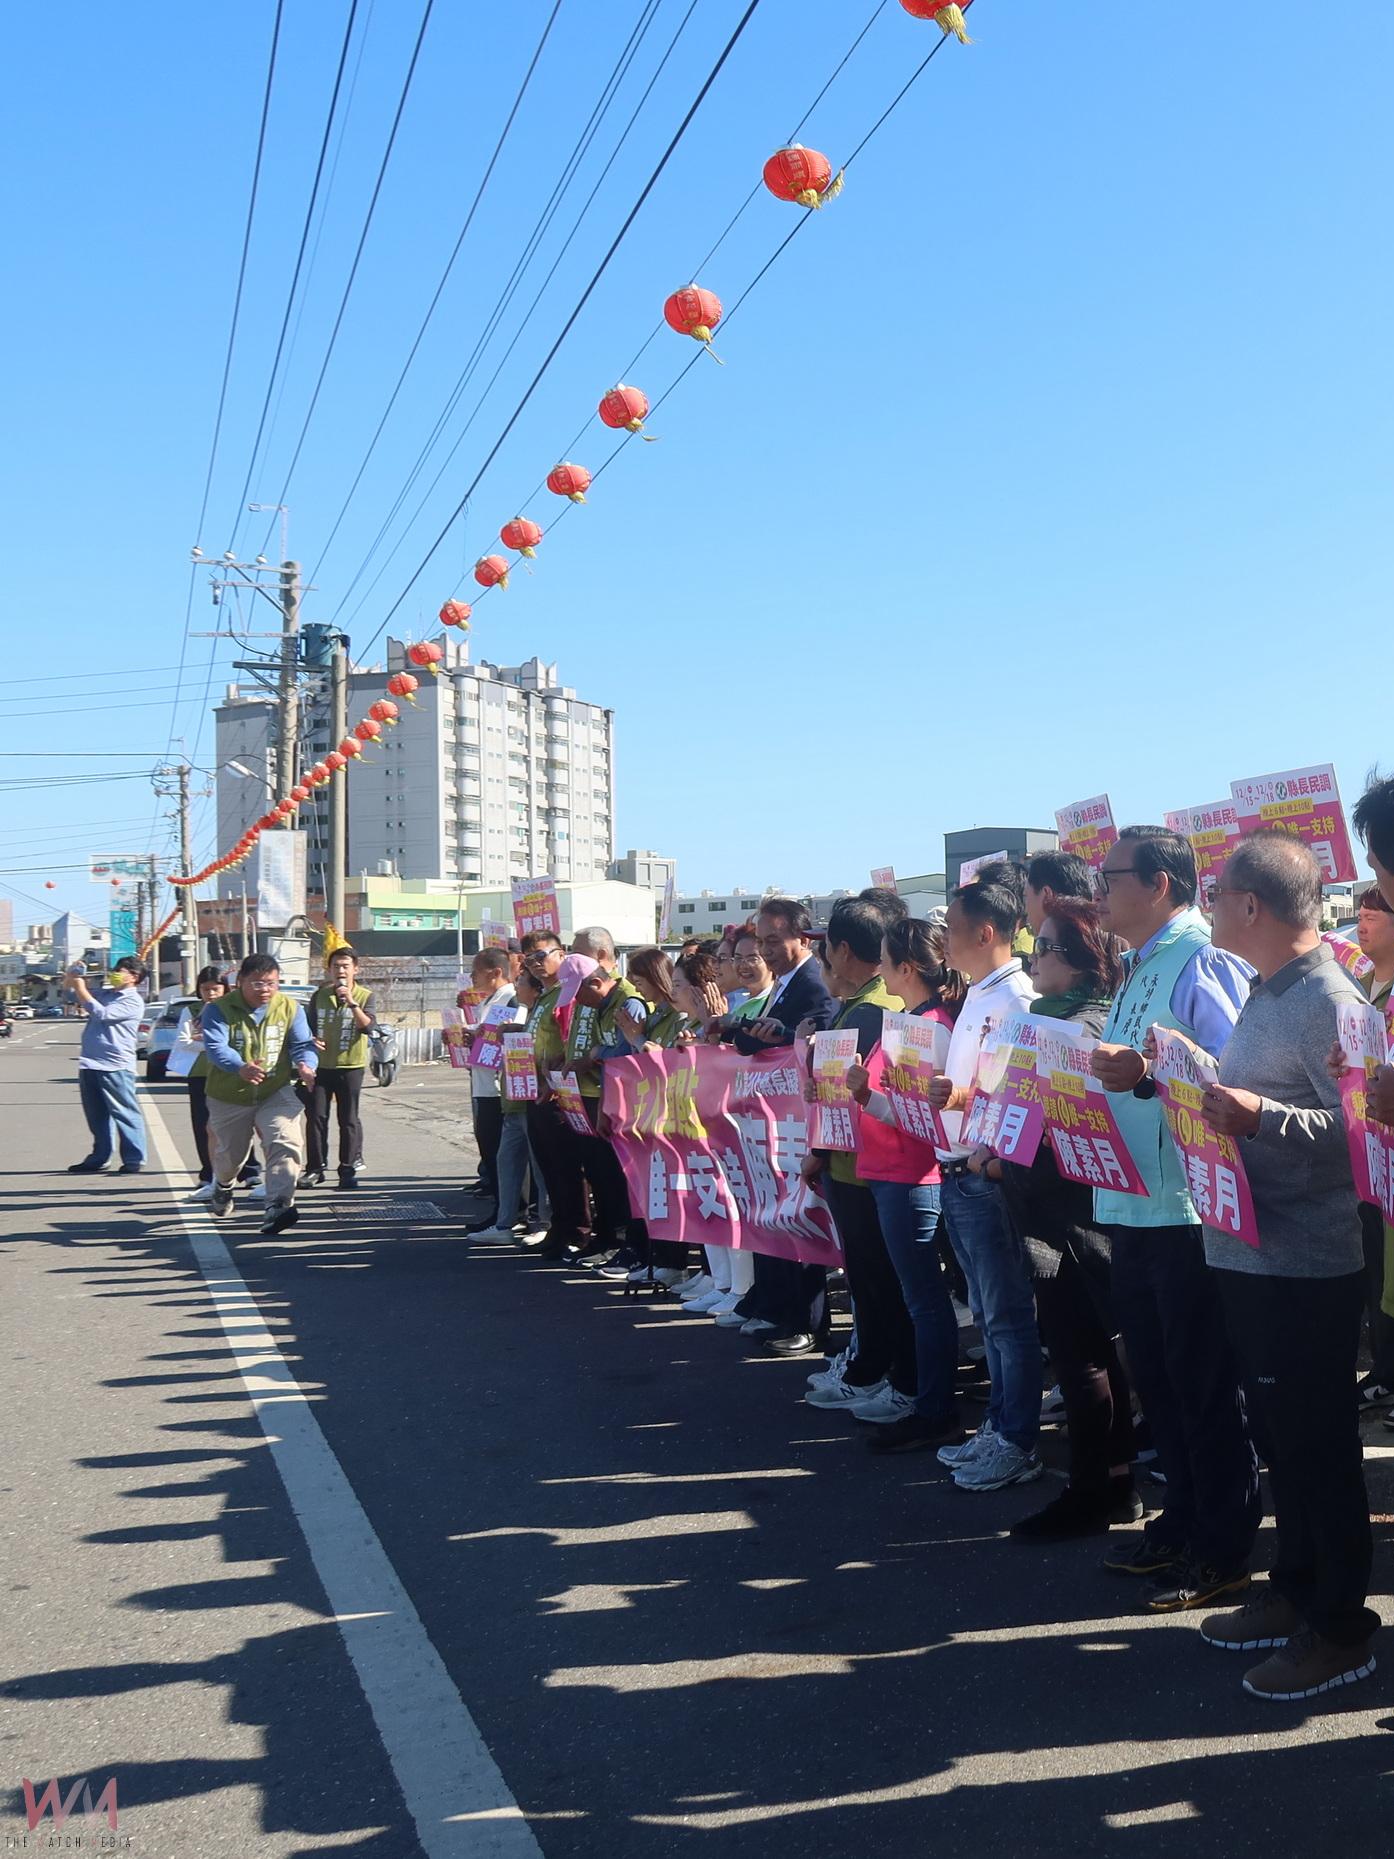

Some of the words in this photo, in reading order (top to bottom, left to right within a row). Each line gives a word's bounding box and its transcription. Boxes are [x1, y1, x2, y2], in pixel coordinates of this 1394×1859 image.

[1287, 773, 1332, 798] 縣長民調
[1287, 815, 1336, 837] 唯一支持
[821, 1106, 856, 1149] 陳素月
[891, 1091, 940, 1145] 陳素月
[961, 1095, 1029, 1156] 陳素月
[1051, 1127, 1130, 1188] 陳素月
